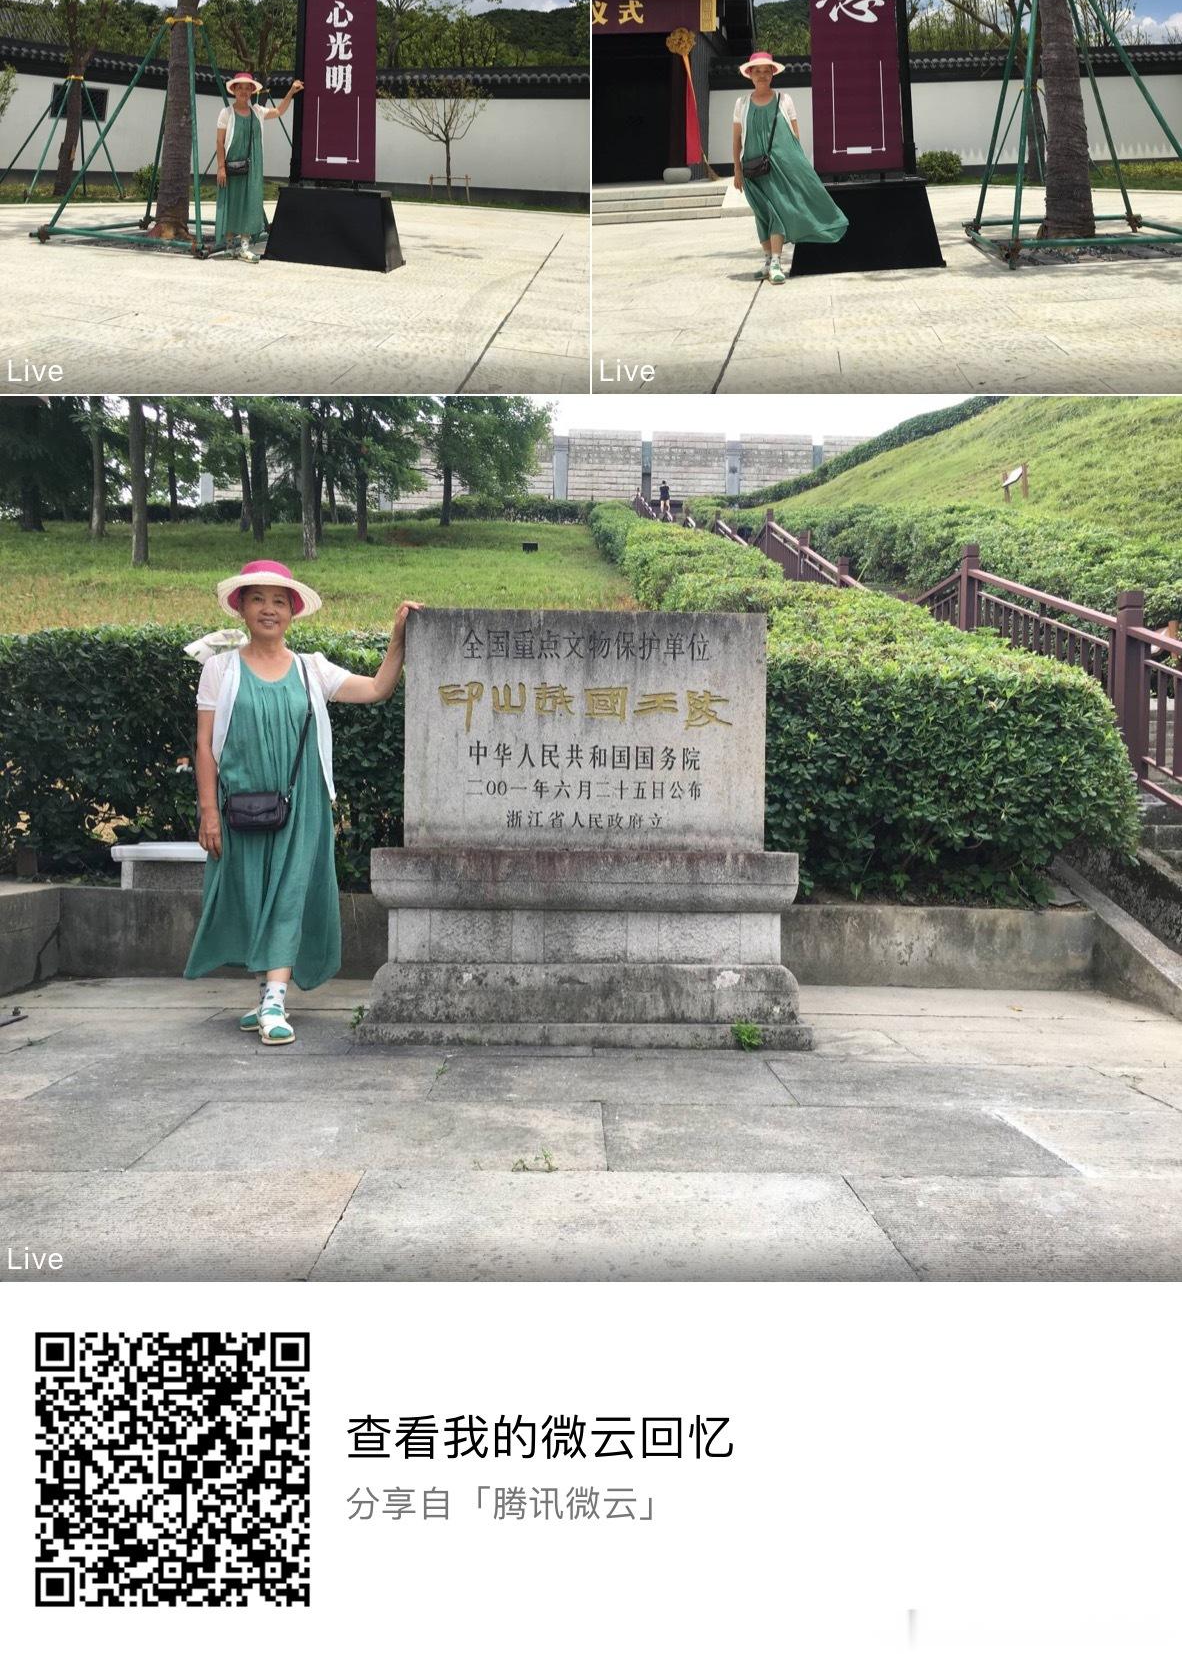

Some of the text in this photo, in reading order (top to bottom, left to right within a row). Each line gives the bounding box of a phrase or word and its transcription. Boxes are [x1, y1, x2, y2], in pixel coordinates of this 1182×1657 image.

[461, 629, 711, 662] 全国重点文物保护单位
[468, 741, 701, 772] 中华人民共和国国务院
[506, 809, 664, 830] 浙江省人民政府立
